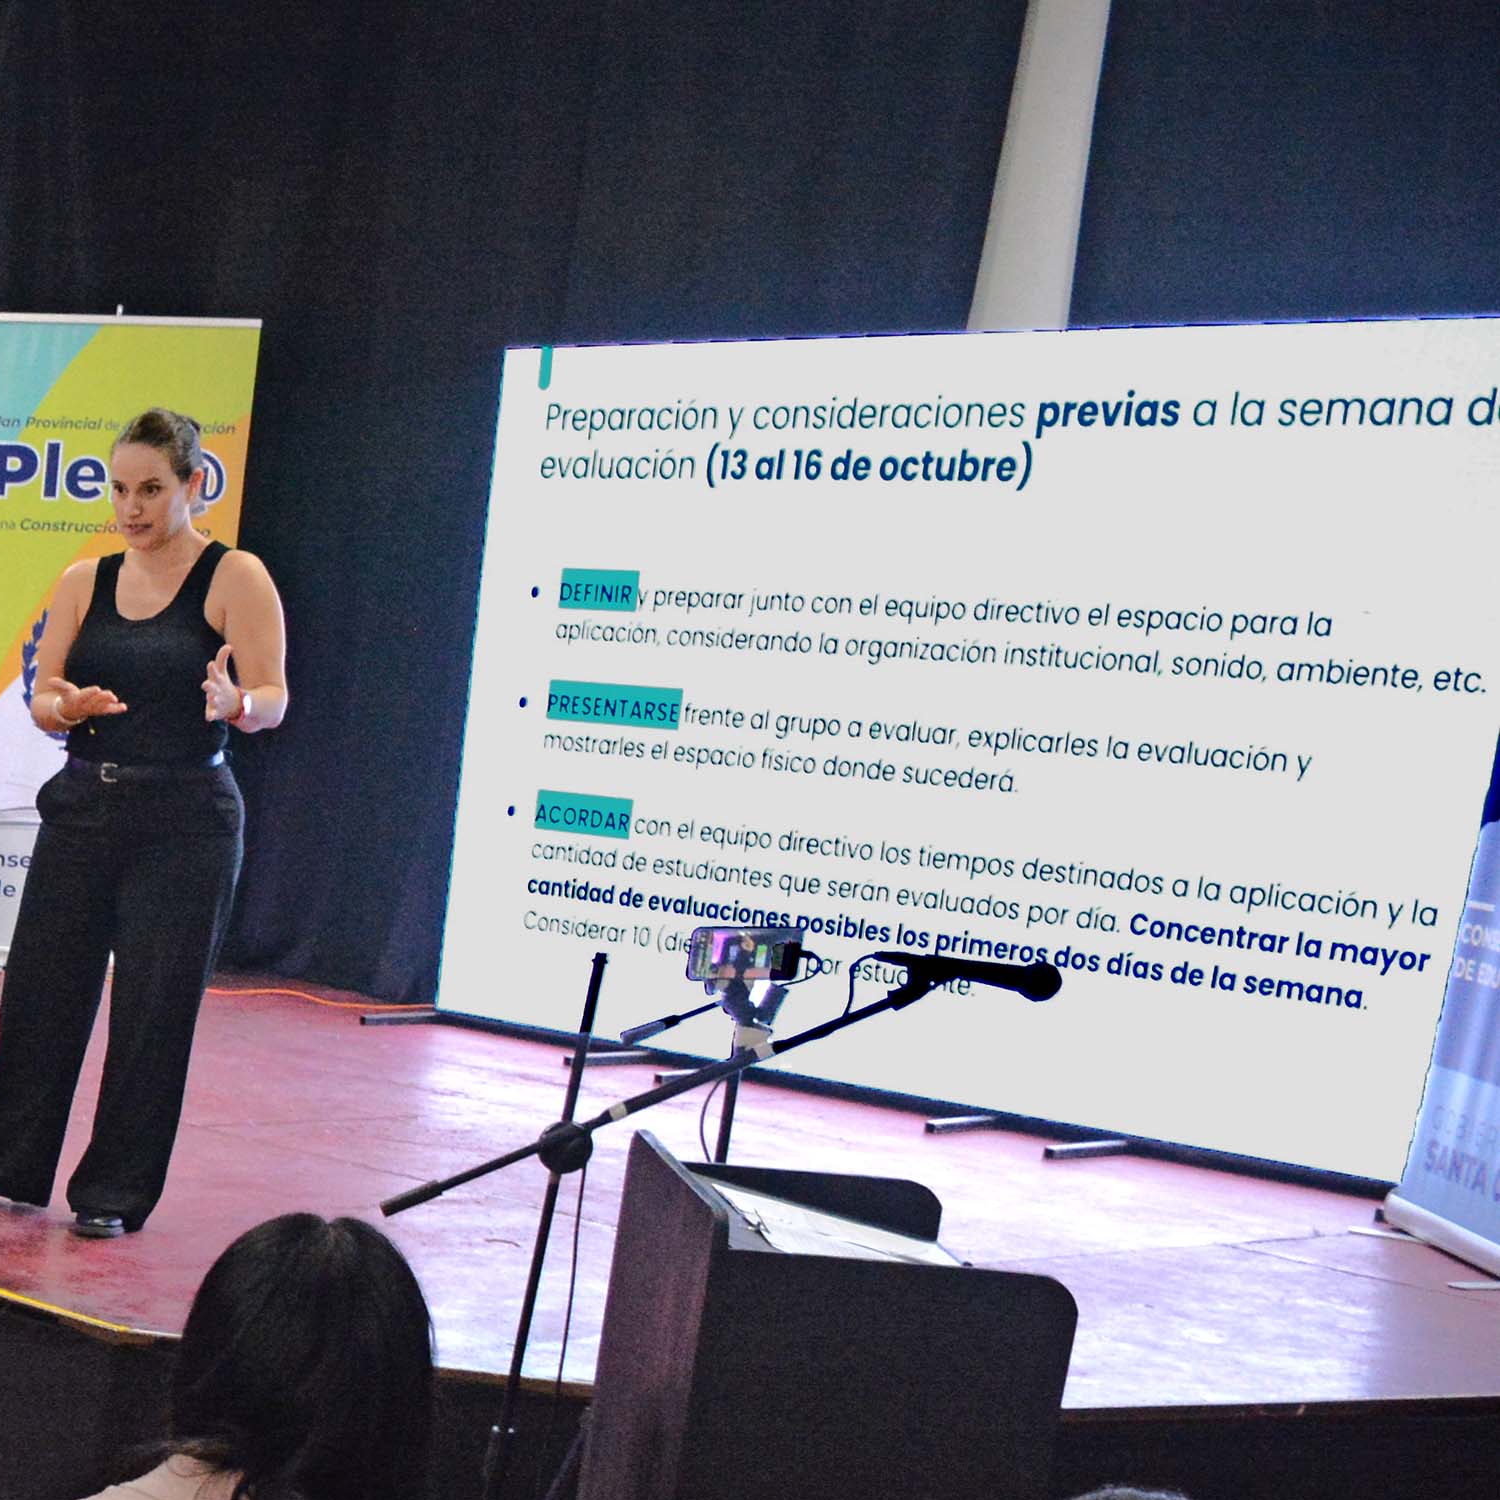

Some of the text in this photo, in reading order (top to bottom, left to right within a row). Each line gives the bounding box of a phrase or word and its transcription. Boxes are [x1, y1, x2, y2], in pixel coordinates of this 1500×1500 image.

[25, 415, 102, 431] Provincial
[546, 387, 1500, 440] Preparación y consideraciones previas a la semana d
[541, 441, 1032, 491] evaluación (13 al 16 de octubre)
[559, 582, 1332, 640] DEFINIR y preparar junto con el equipo directivo el espacio para la
[556, 623, 1486, 693] aplicación, considerando la organización institucional, sonido, ambiente, etc.
[544, 734, 1018, 793] mostrarles el espacio físico donde sucederá.
[547, 693, 1312, 781] PRESENTARSE frente al grupo a evaluar, explicarles la evaluación y
[535, 803, 1438, 929] ACORDAR con el equipo directivo los tiempos destinados a la aplicación y la
[532, 844, 1431, 976] cantidad de estudiantes que serán evaluados por día. Concentrar la mayor
[525, 911, 626, 942] Considerar
[634, 926, 649, 947] 10
[656, 926, 693, 955] (die
[806, 957, 841, 978] por
[528, 878, 1367, 1010] cantidad de evaluaciones posibles los primeros dos días de la semana.
[1424, 1140, 1487, 1195] SANTA
